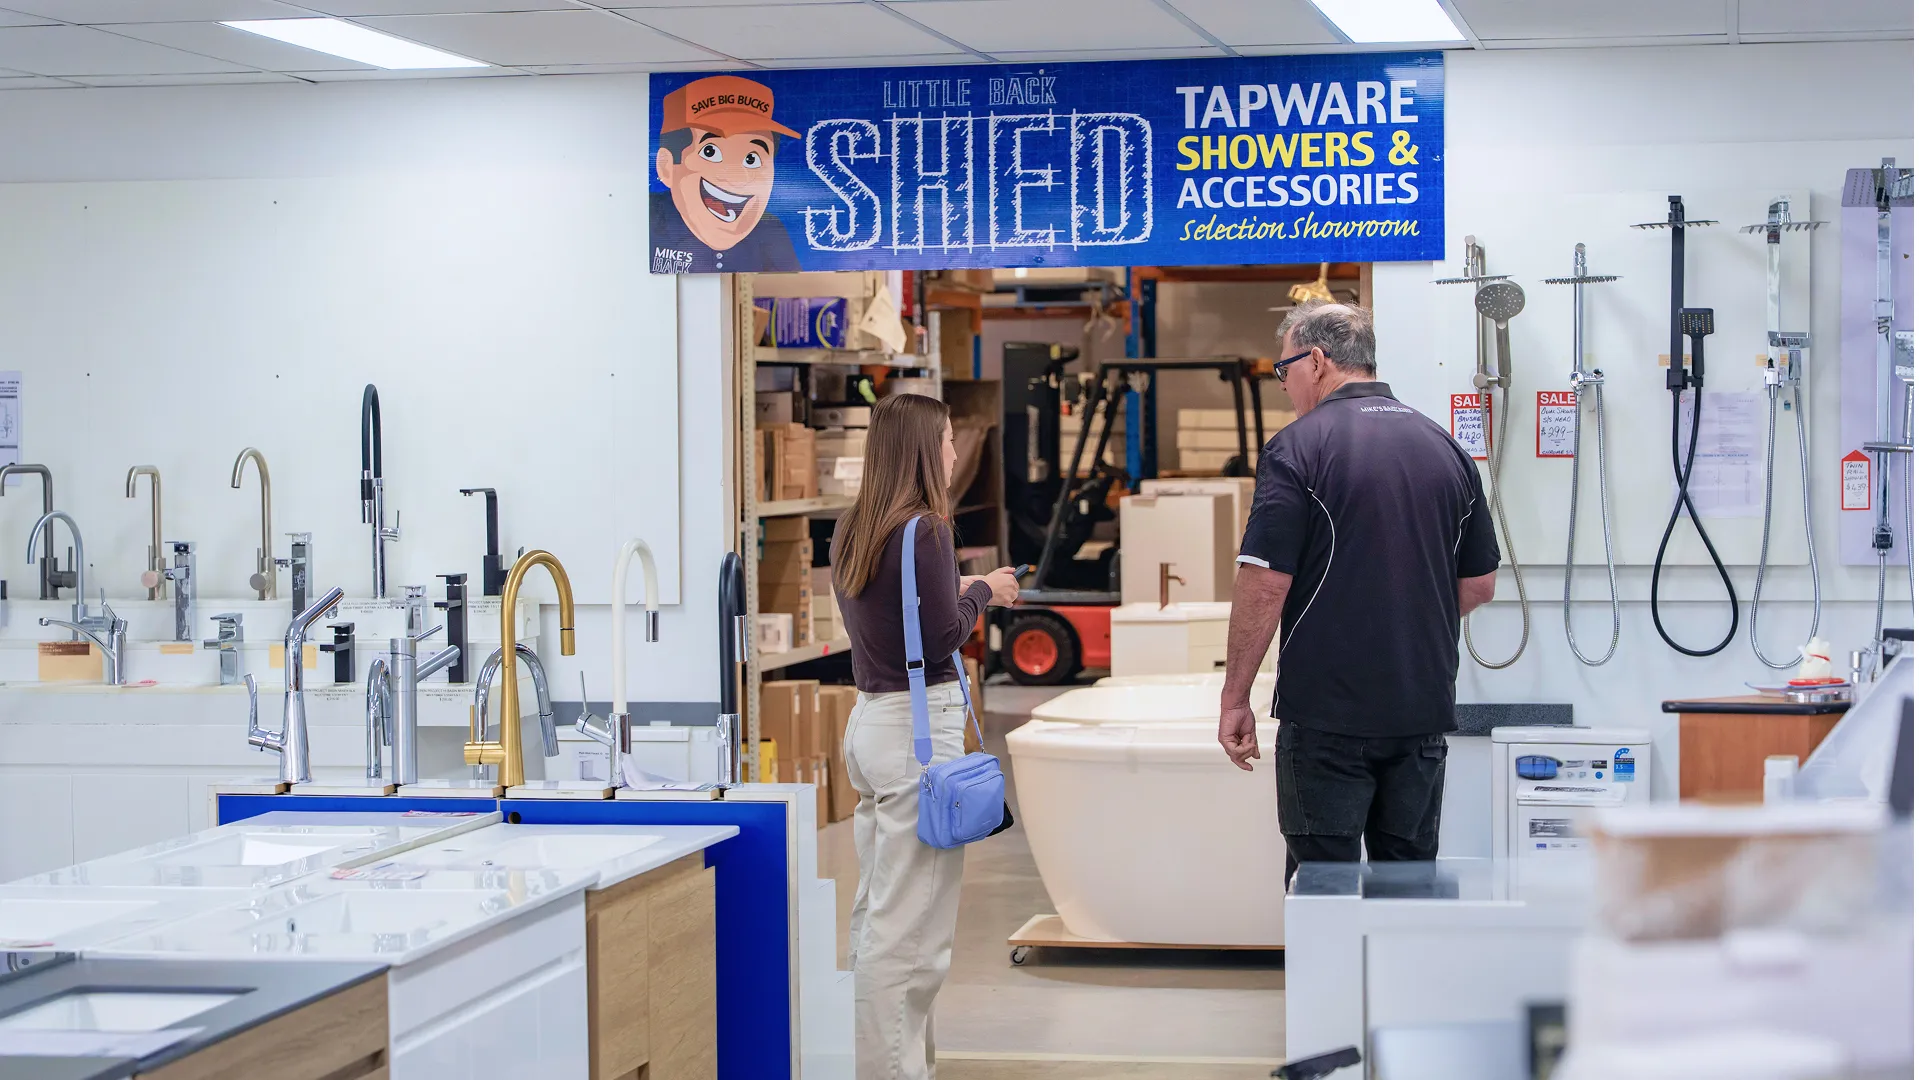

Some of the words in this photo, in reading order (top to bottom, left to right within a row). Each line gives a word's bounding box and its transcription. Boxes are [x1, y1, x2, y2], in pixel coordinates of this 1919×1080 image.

[691, 96, 716, 114] SAVE
[718, 94, 735, 105] BIG
[883, 79, 971, 108] LITTLE
[989, 76, 1057, 106] BACK
[1176, 80, 1420, 129] TAPWARE
[1176, 131, 1375, 171] SHOWERS
[1387, 129, 1420, 167] &
[803, 110, 1153, 253] SHED
[1176, 172, 1420, 209] ACCESSORIES
[1179, 214, 1286, 242] Selection
[1288, 211, 1421, 240] Showroom
[652, 257, 693, 274] BACK
[655, 247, 693, 262] MIKE'S
[1540, 392, 1576, 404] SALE
[1457, 415, 1482, 423] BRUSHE
[1459, 422, 1482, 430] NICKE
